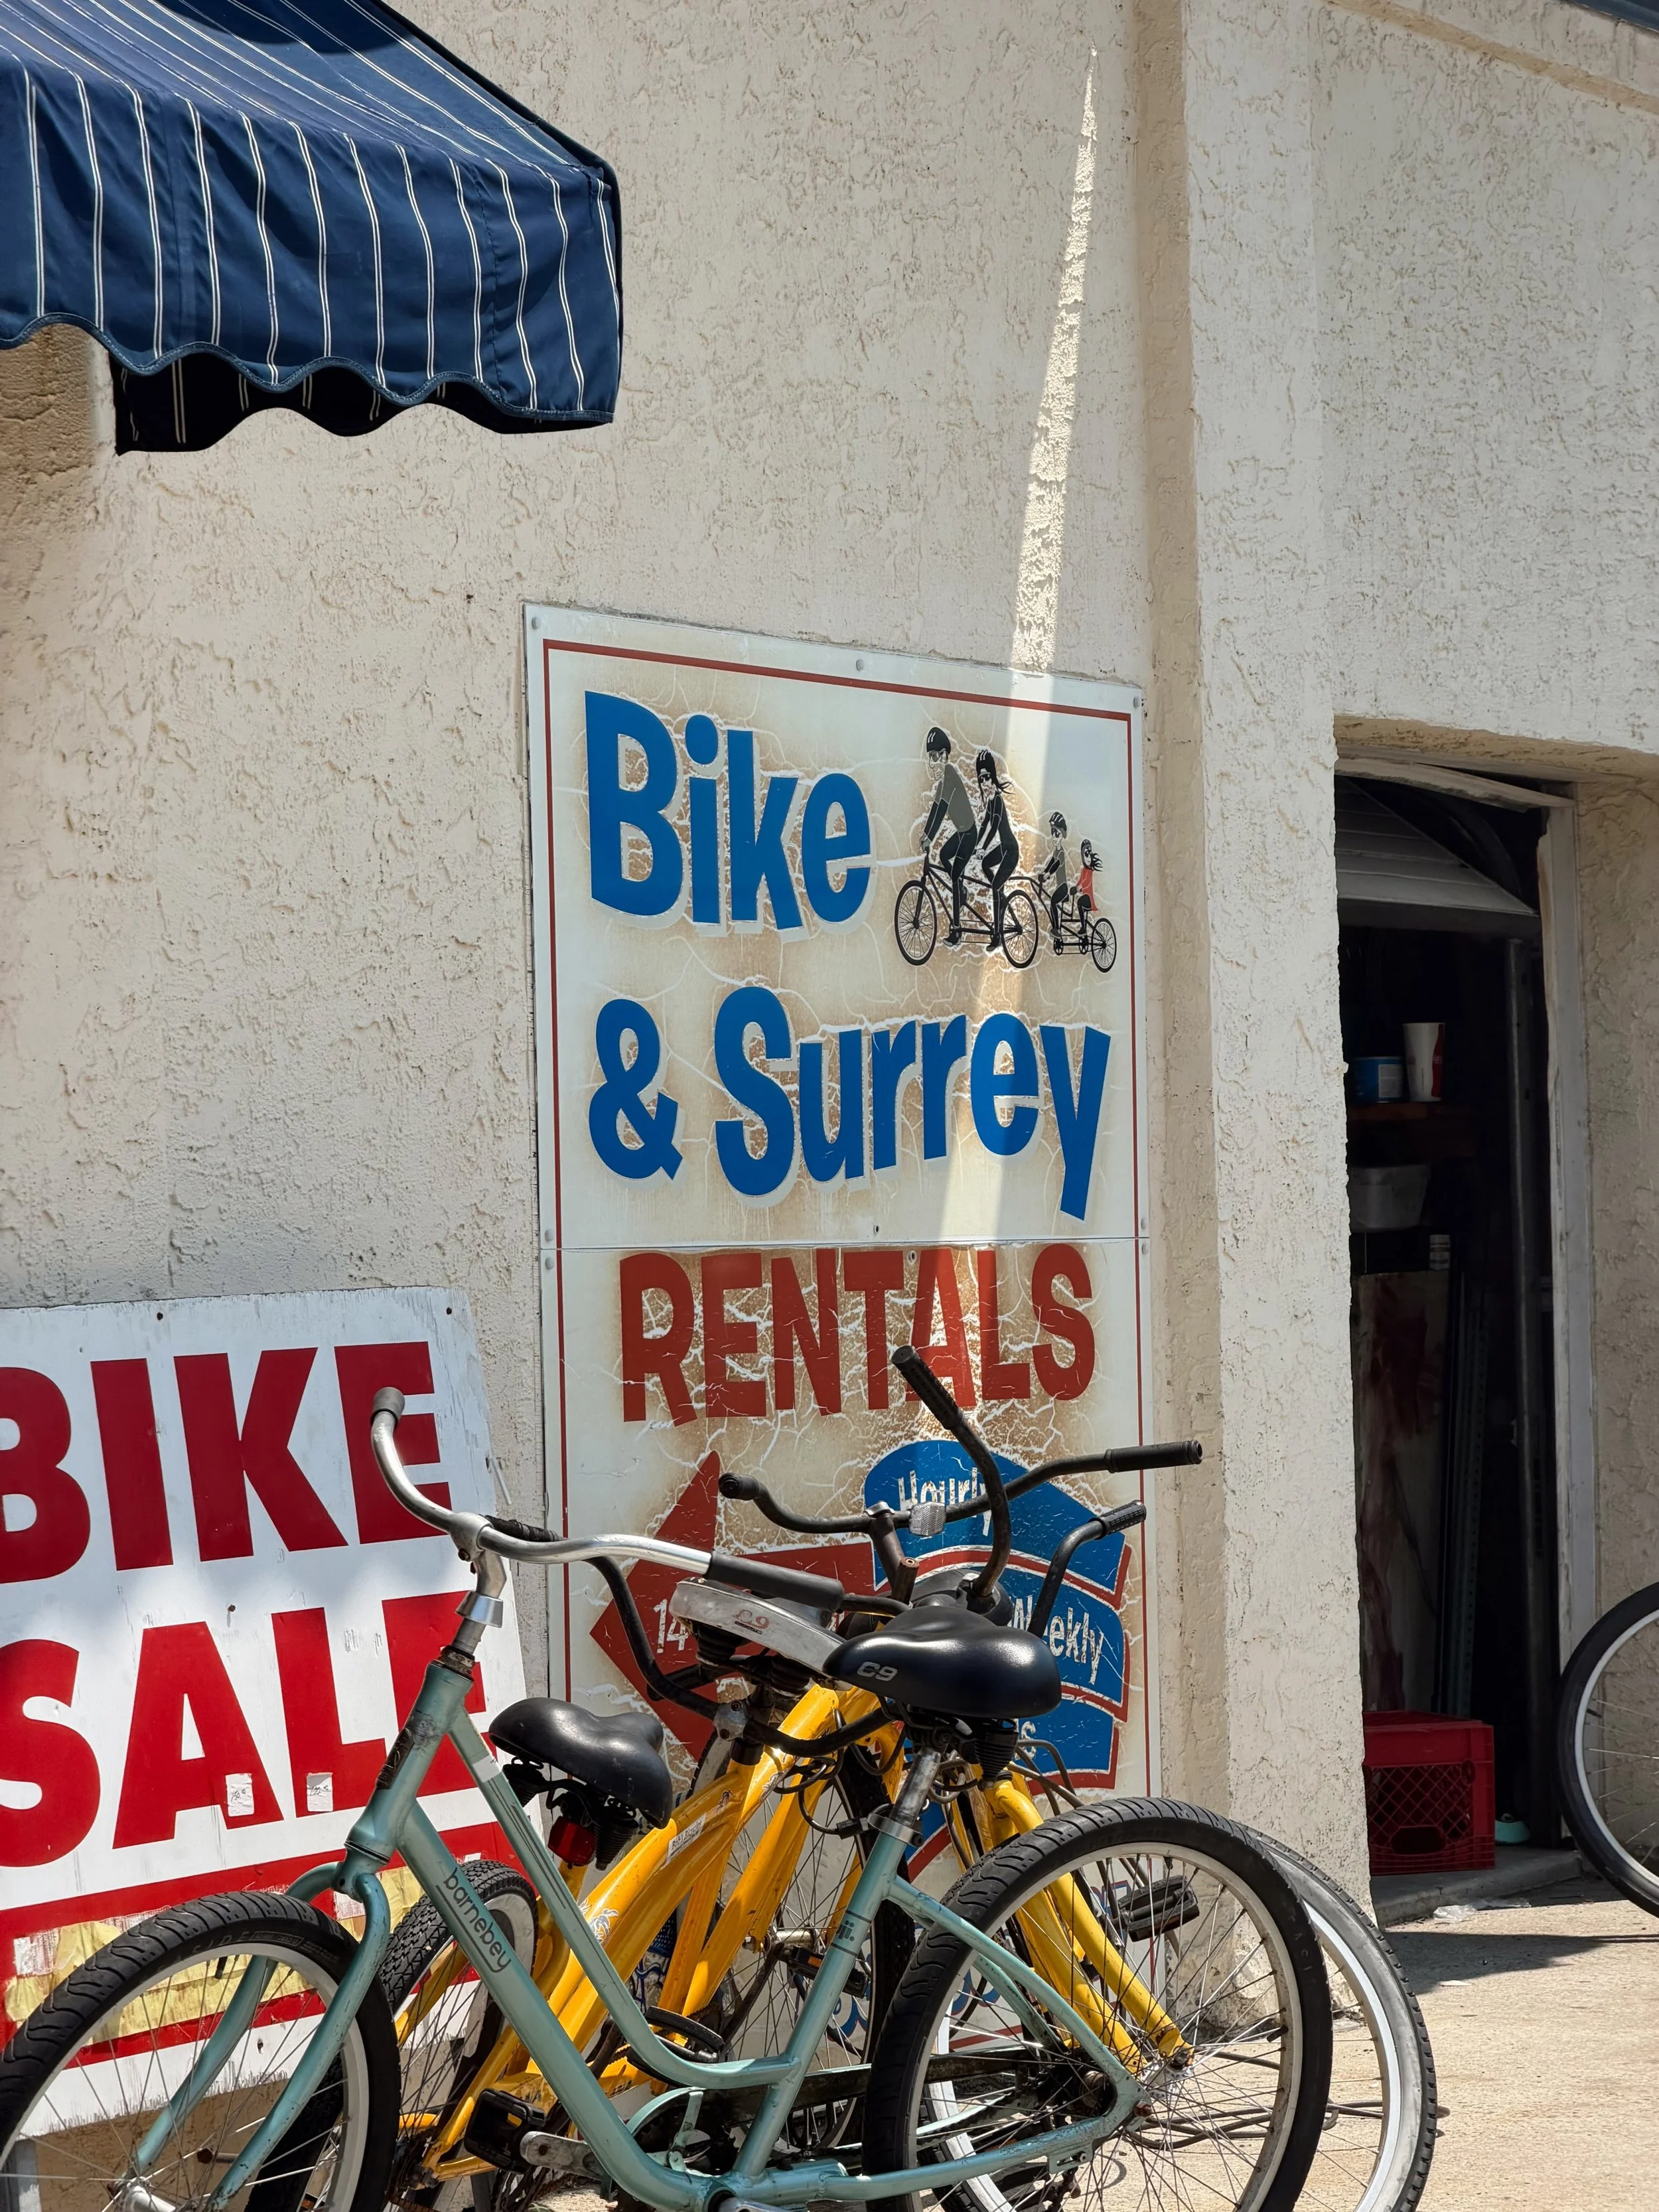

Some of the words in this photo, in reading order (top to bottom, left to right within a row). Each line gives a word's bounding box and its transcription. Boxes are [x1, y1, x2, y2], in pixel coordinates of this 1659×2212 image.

[585, 691, 871, 929] Bike
[589, 999, 684, 1181] &
[713, 986, 1111, 1221] Surrey
[620, 1244, 1094, 1426] RENTALS
[0, 1341, 453, 1584] BIKE
[898, 1467, 992, 1537] Hourly
[0, 1590, 498, 1866] SALE
[857, 1661, 898, 1682] C9
[1007, 1594, 1104, 1686] Wekly
[443, 1867, 512, 1972] barnebey
